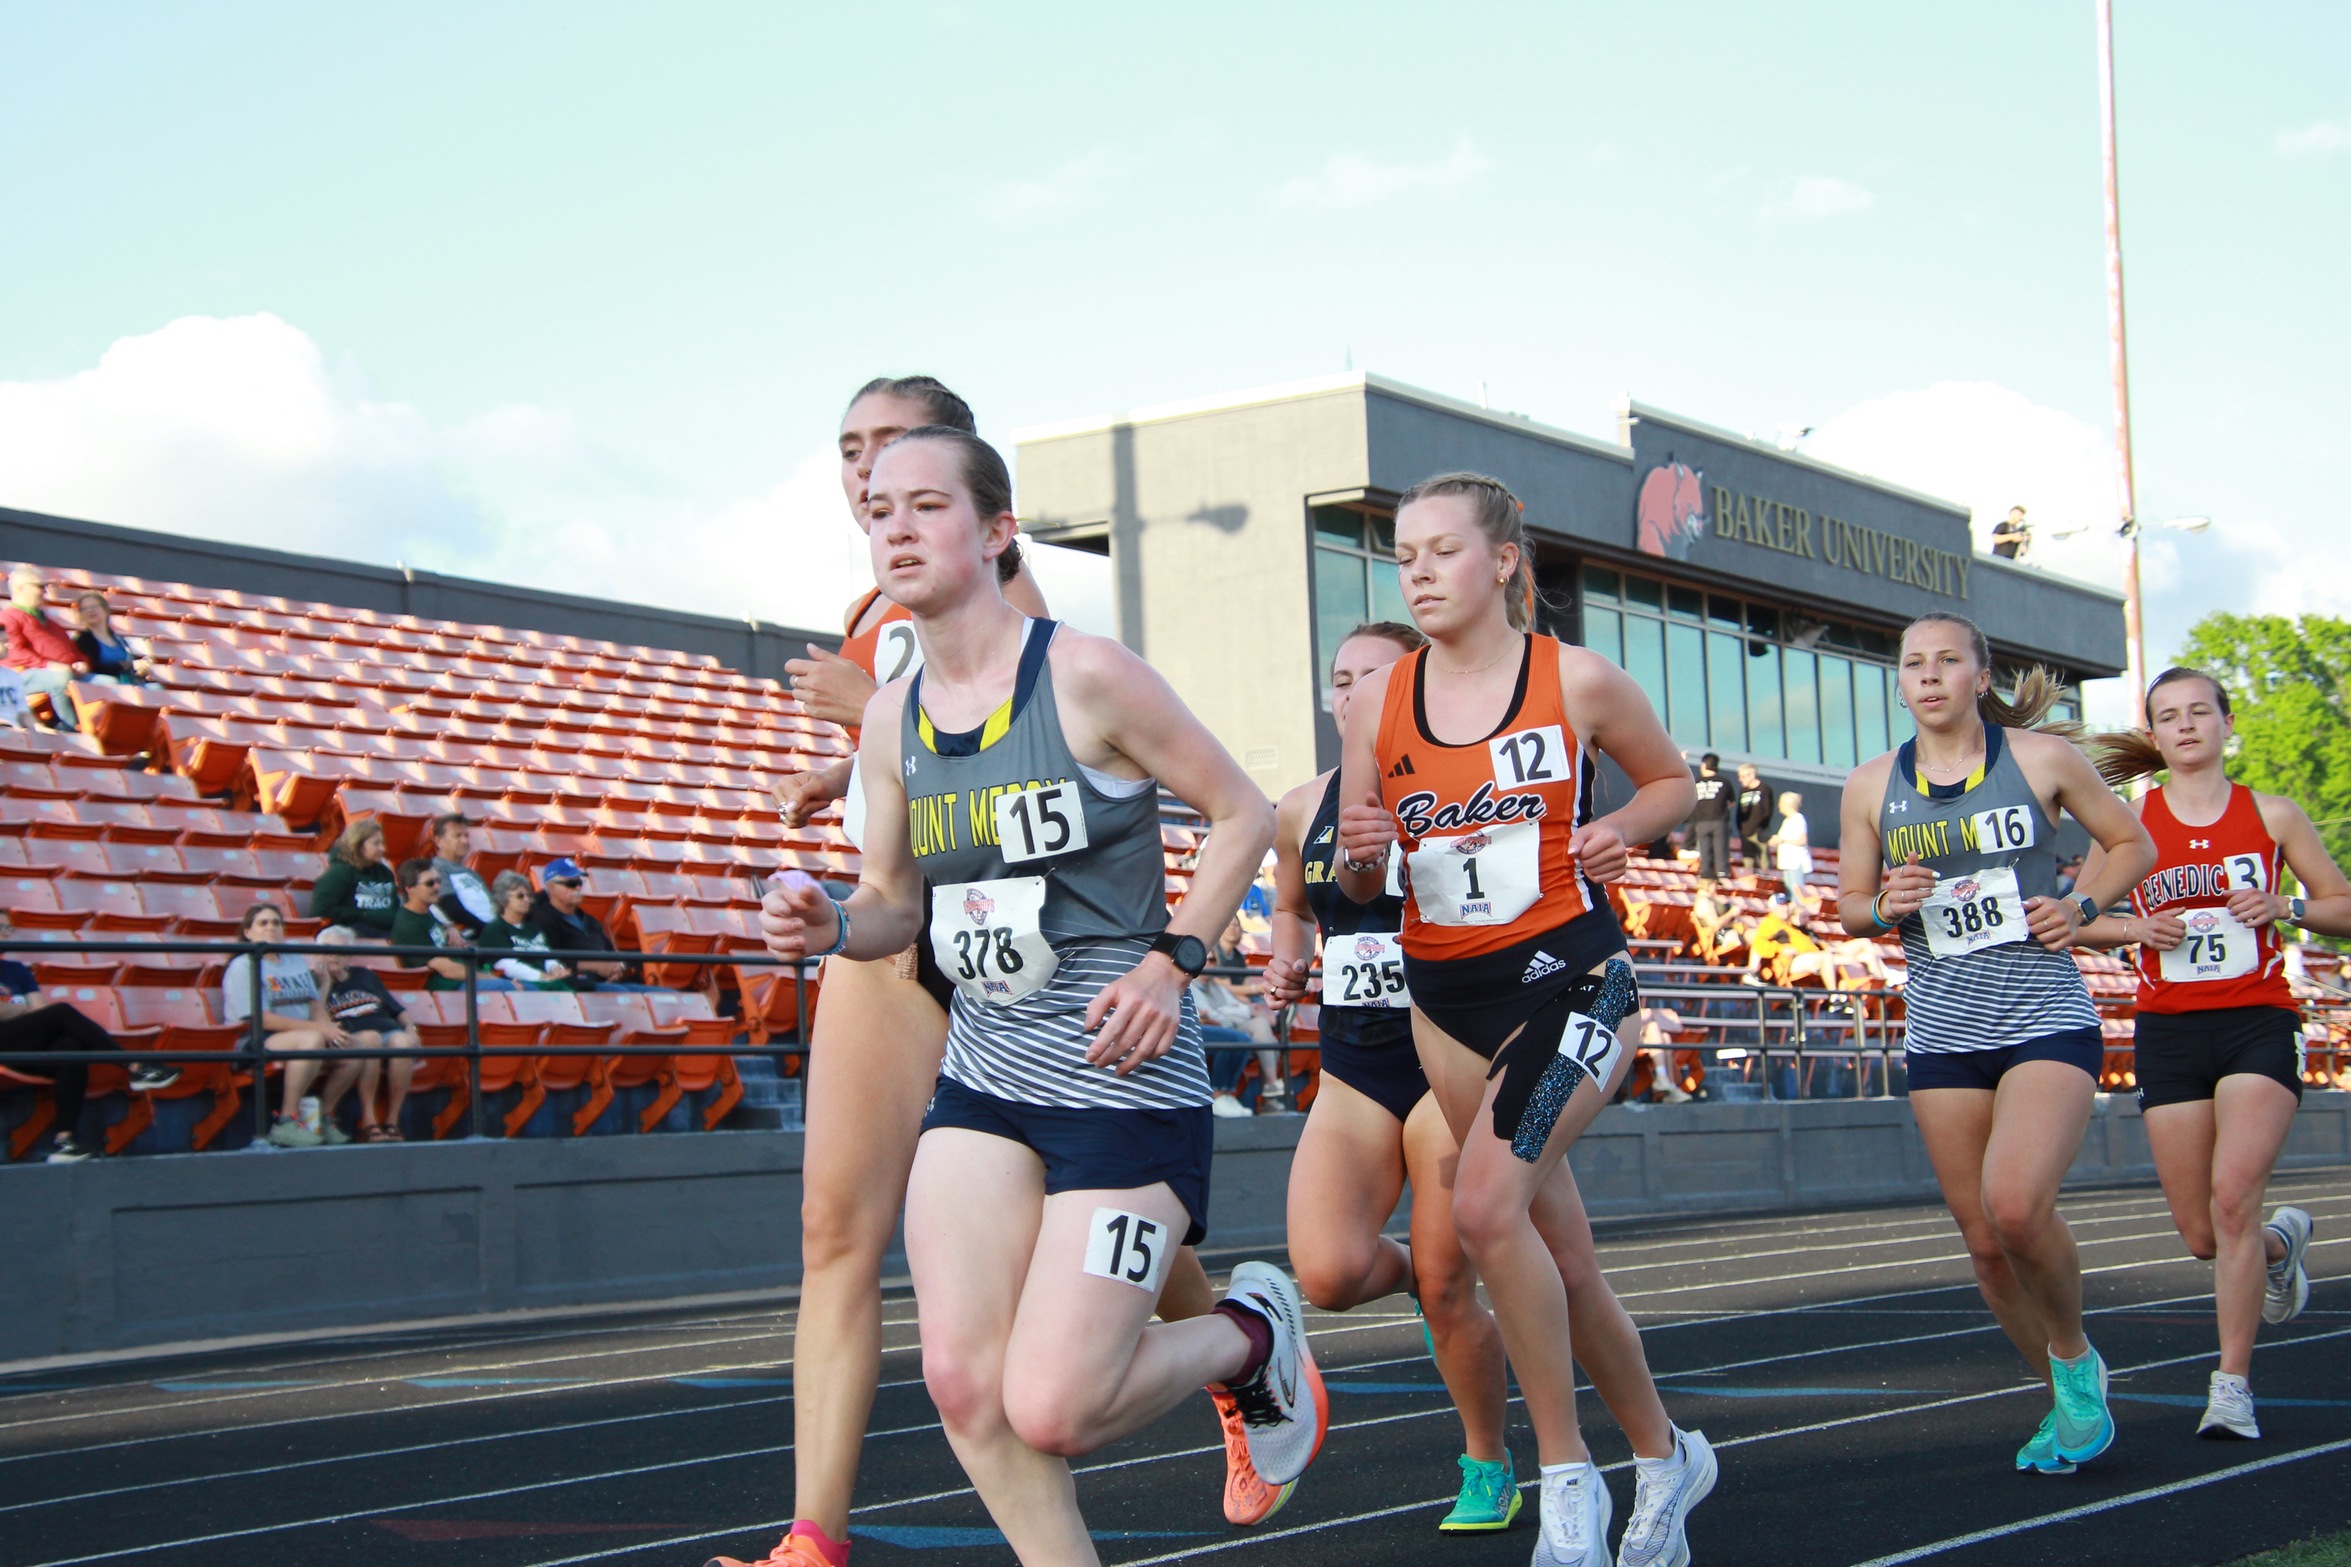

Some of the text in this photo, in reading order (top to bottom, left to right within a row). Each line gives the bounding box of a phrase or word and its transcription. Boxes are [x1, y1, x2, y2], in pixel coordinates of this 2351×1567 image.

[1712, 486, 1971, 600] BAKER UNIVERSITY
[1498, 732, 1552, 783] 12
[1009, 788, 1070, 855] 15
[1396, 780, 1547, 837] Baker
[1984, 808, 2025, 849] 16
[1887, 820, 1950, 867] MOUNT
[1462, 857, 1485, 900] 1
[2142, 864, 2225, 910] BENEDIC
[1461, 903, 1491, 917] NAIA
[1942, 896, 2003, 939] 388
[952, 926, 1024, 980] 378
[1521, 959, 1566, 984] adidas
[2187, 933, 2226, 964] 75
[1341, 960, 1405, 1002] 235
[1574, 1020, 1613, 1079] 12
[1106, 1214, 1157, 1283] 15
